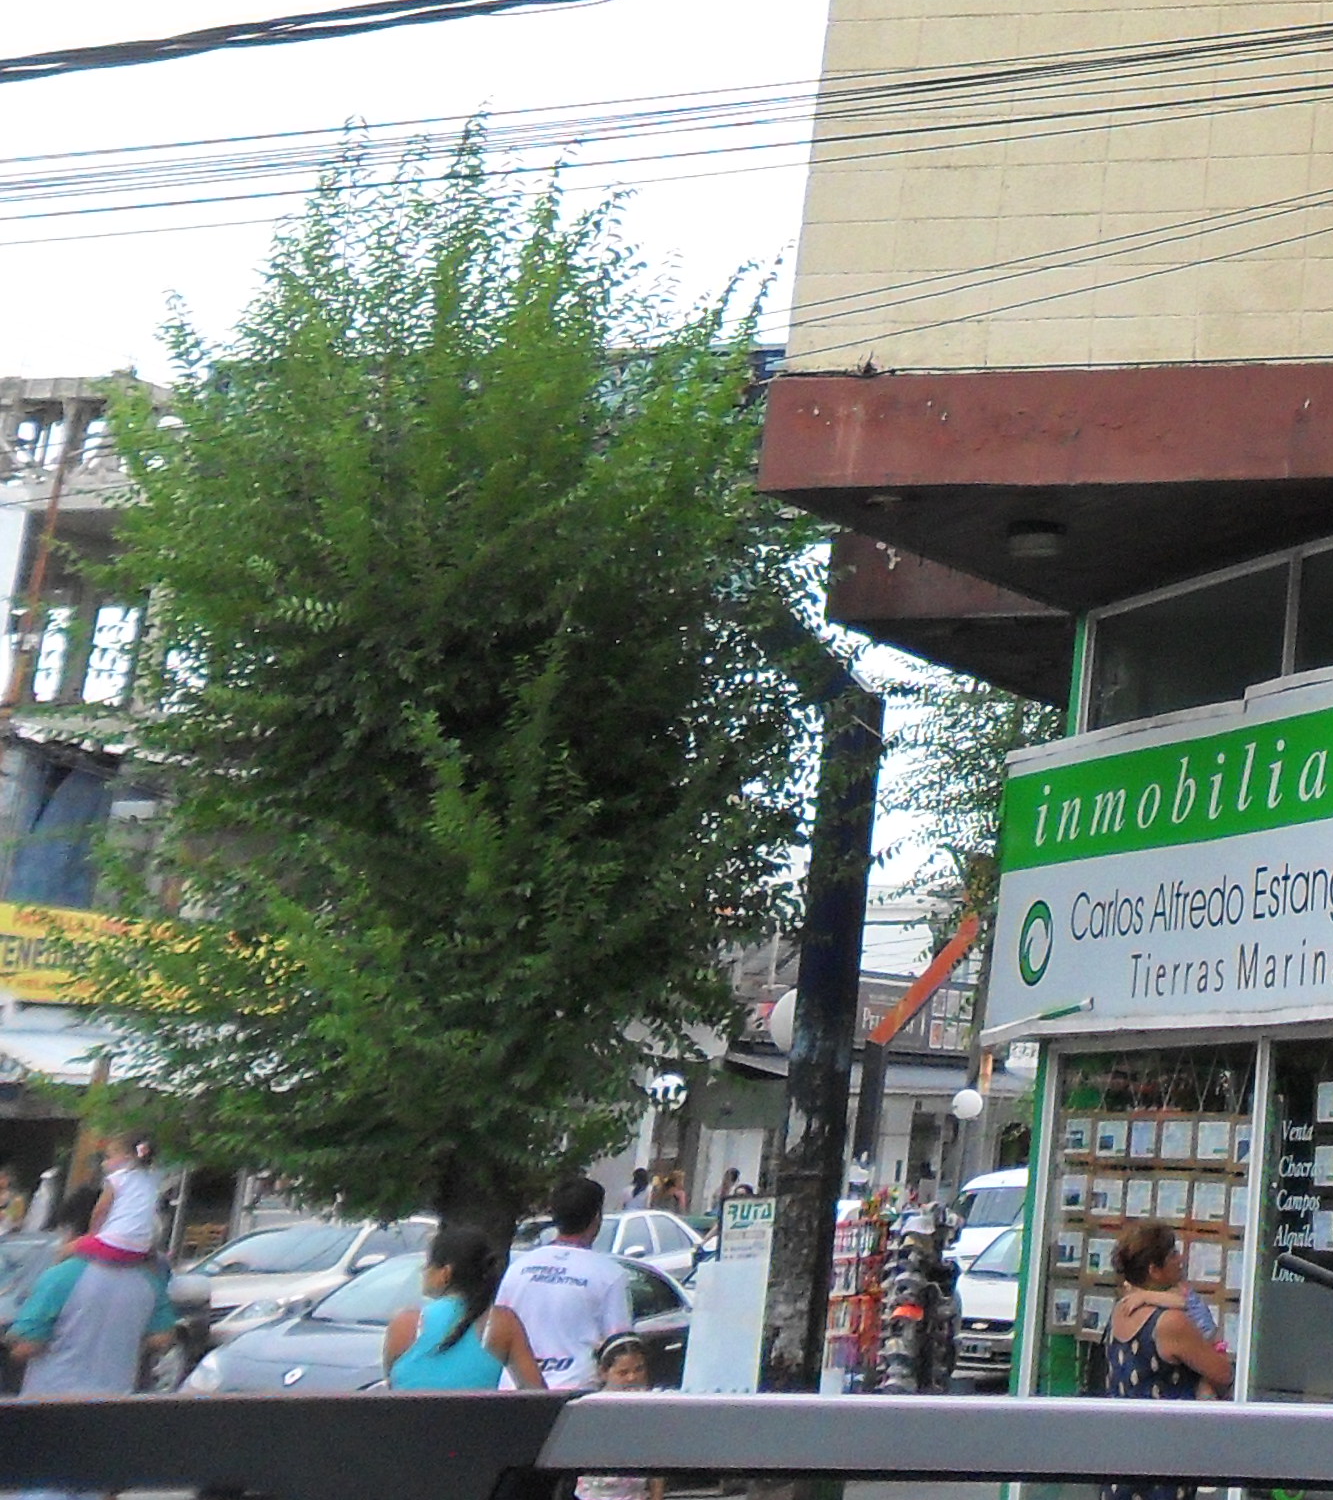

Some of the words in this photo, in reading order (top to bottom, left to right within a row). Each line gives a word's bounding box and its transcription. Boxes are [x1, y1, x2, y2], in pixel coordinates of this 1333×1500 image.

[1070, 888, 1145, 941] Carlos
[1149, 874, 1245, 933] Alfredo
[1130, 952, 1225, 999] Tierras
